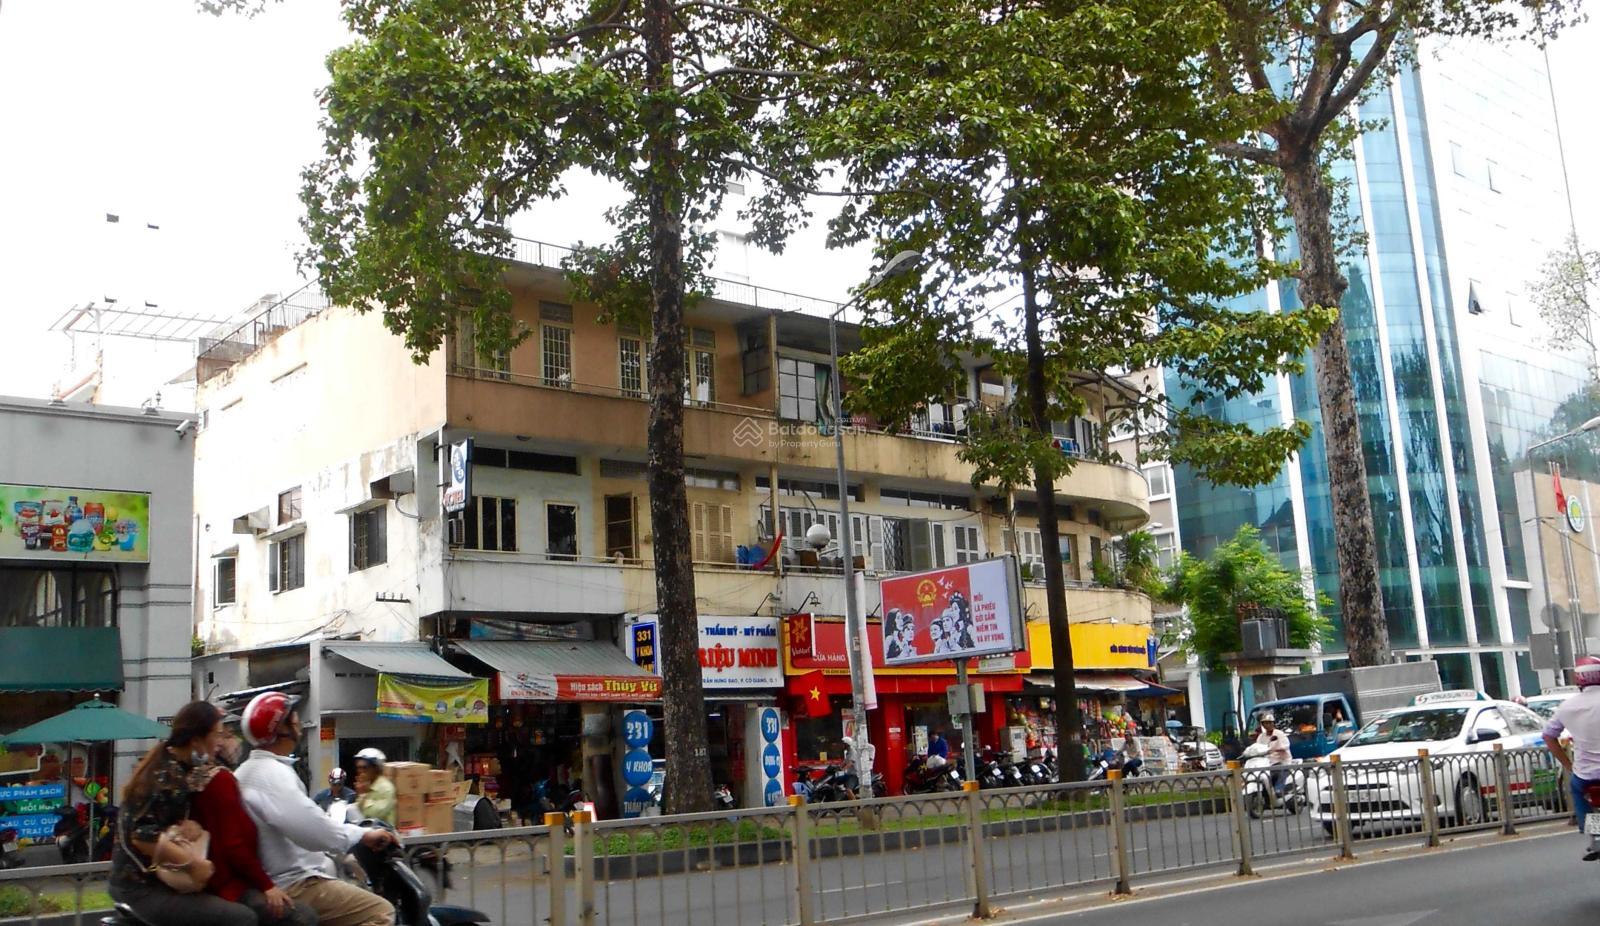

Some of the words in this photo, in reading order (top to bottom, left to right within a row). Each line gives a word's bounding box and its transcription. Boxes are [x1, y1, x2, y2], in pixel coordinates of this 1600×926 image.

[637, 630, 651, 641] 331
[697, 643, 735, 672] RIỆU
[738, 648, 778, 668] MINH
[604, 680, 637, 692] Thúy
[627, 721, 649, 740] 331
[766, 717, 777, 733] 331
